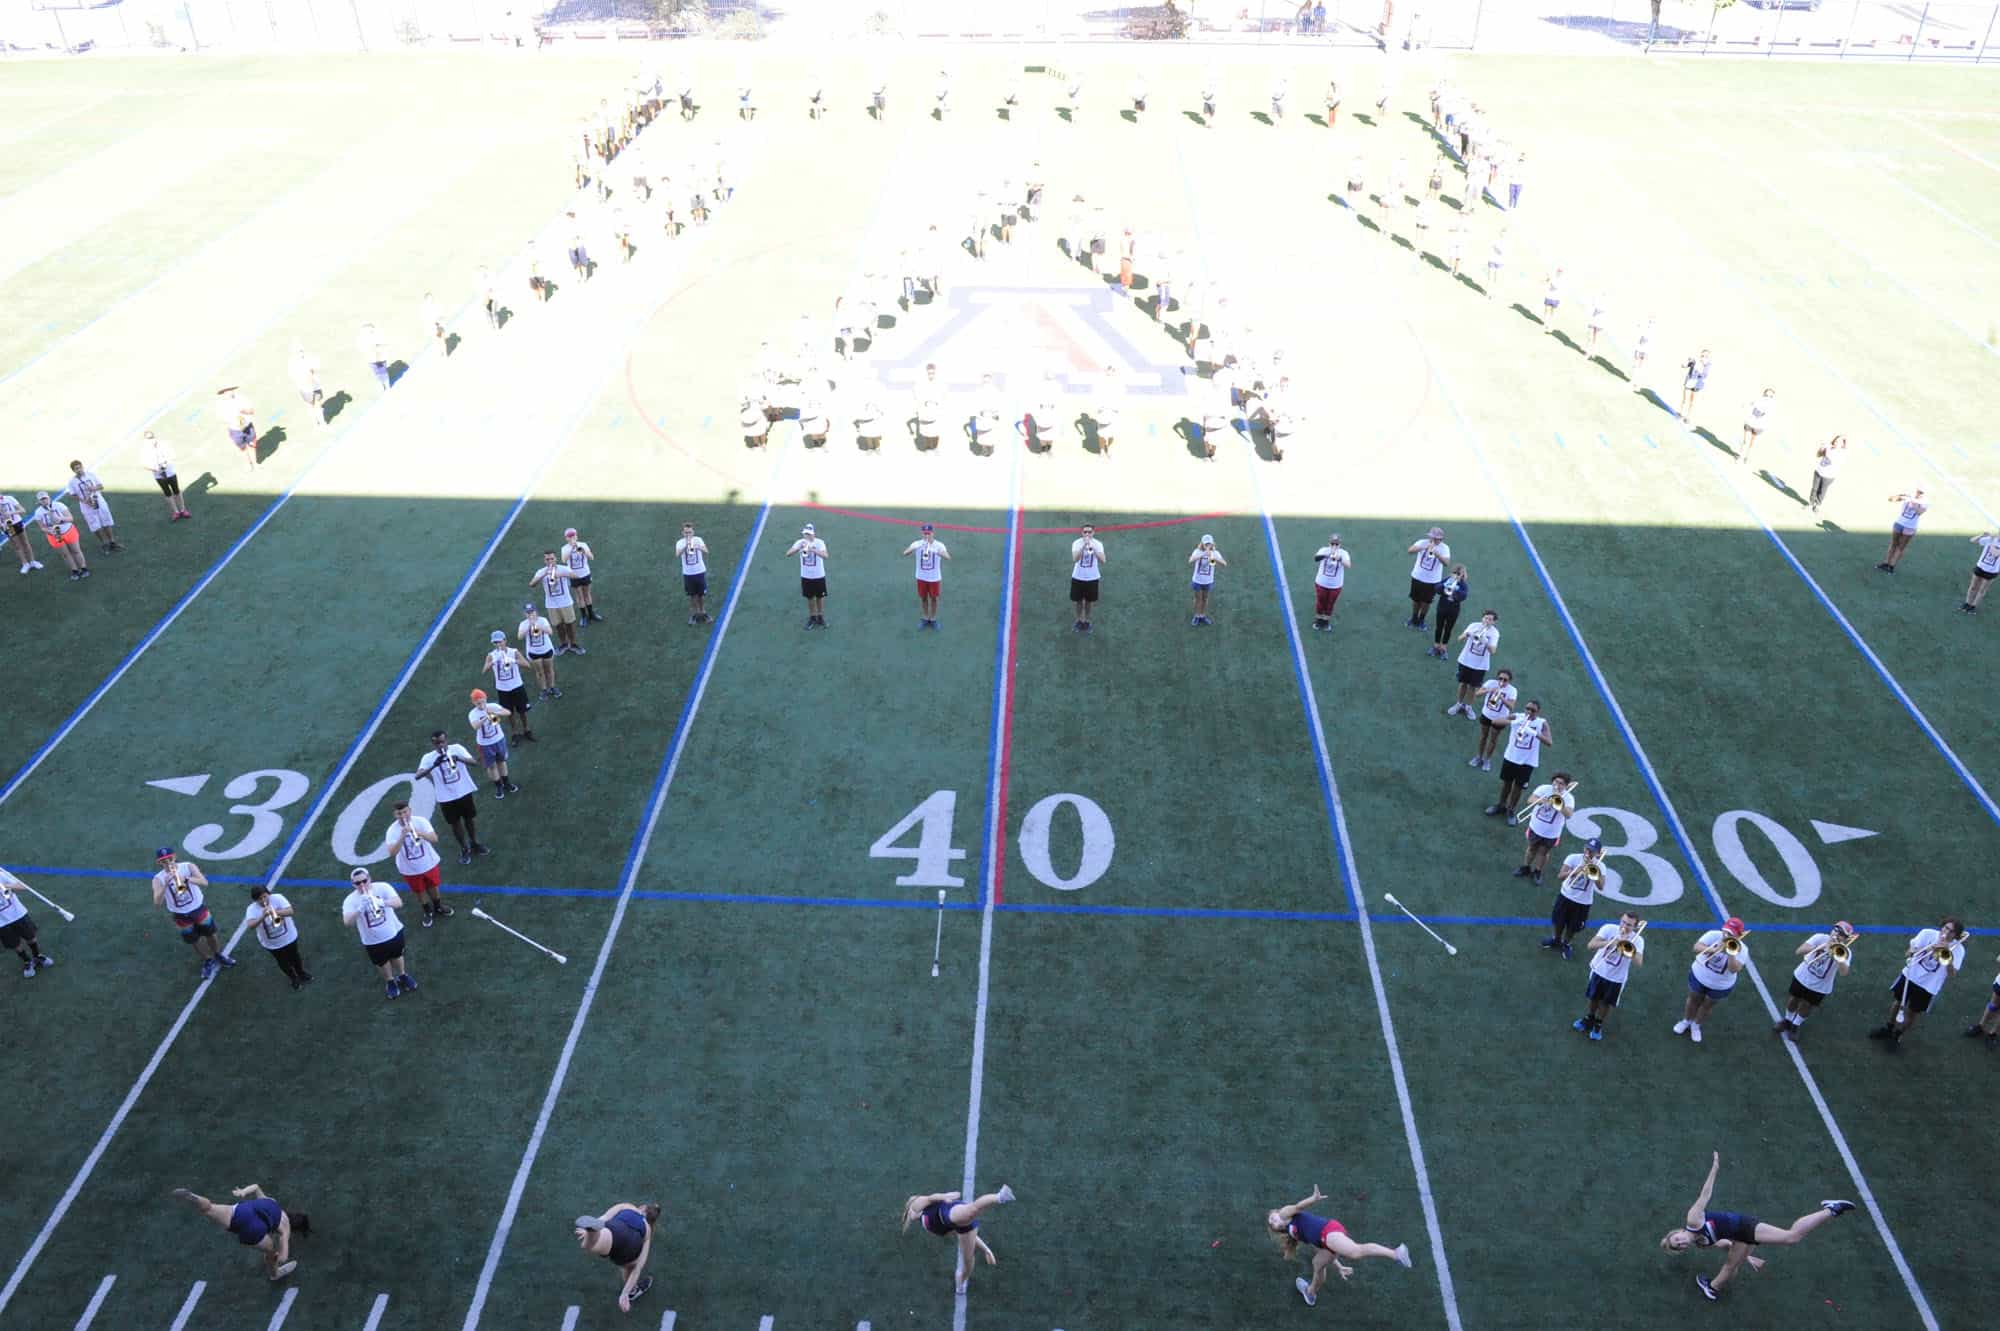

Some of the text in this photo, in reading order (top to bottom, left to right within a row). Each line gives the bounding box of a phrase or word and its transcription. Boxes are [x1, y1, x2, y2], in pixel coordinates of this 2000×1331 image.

[182, 769, 436, 866] 30
[869, 790, 1116, 891] 40
[1566, 807, 1824, 908] 30
